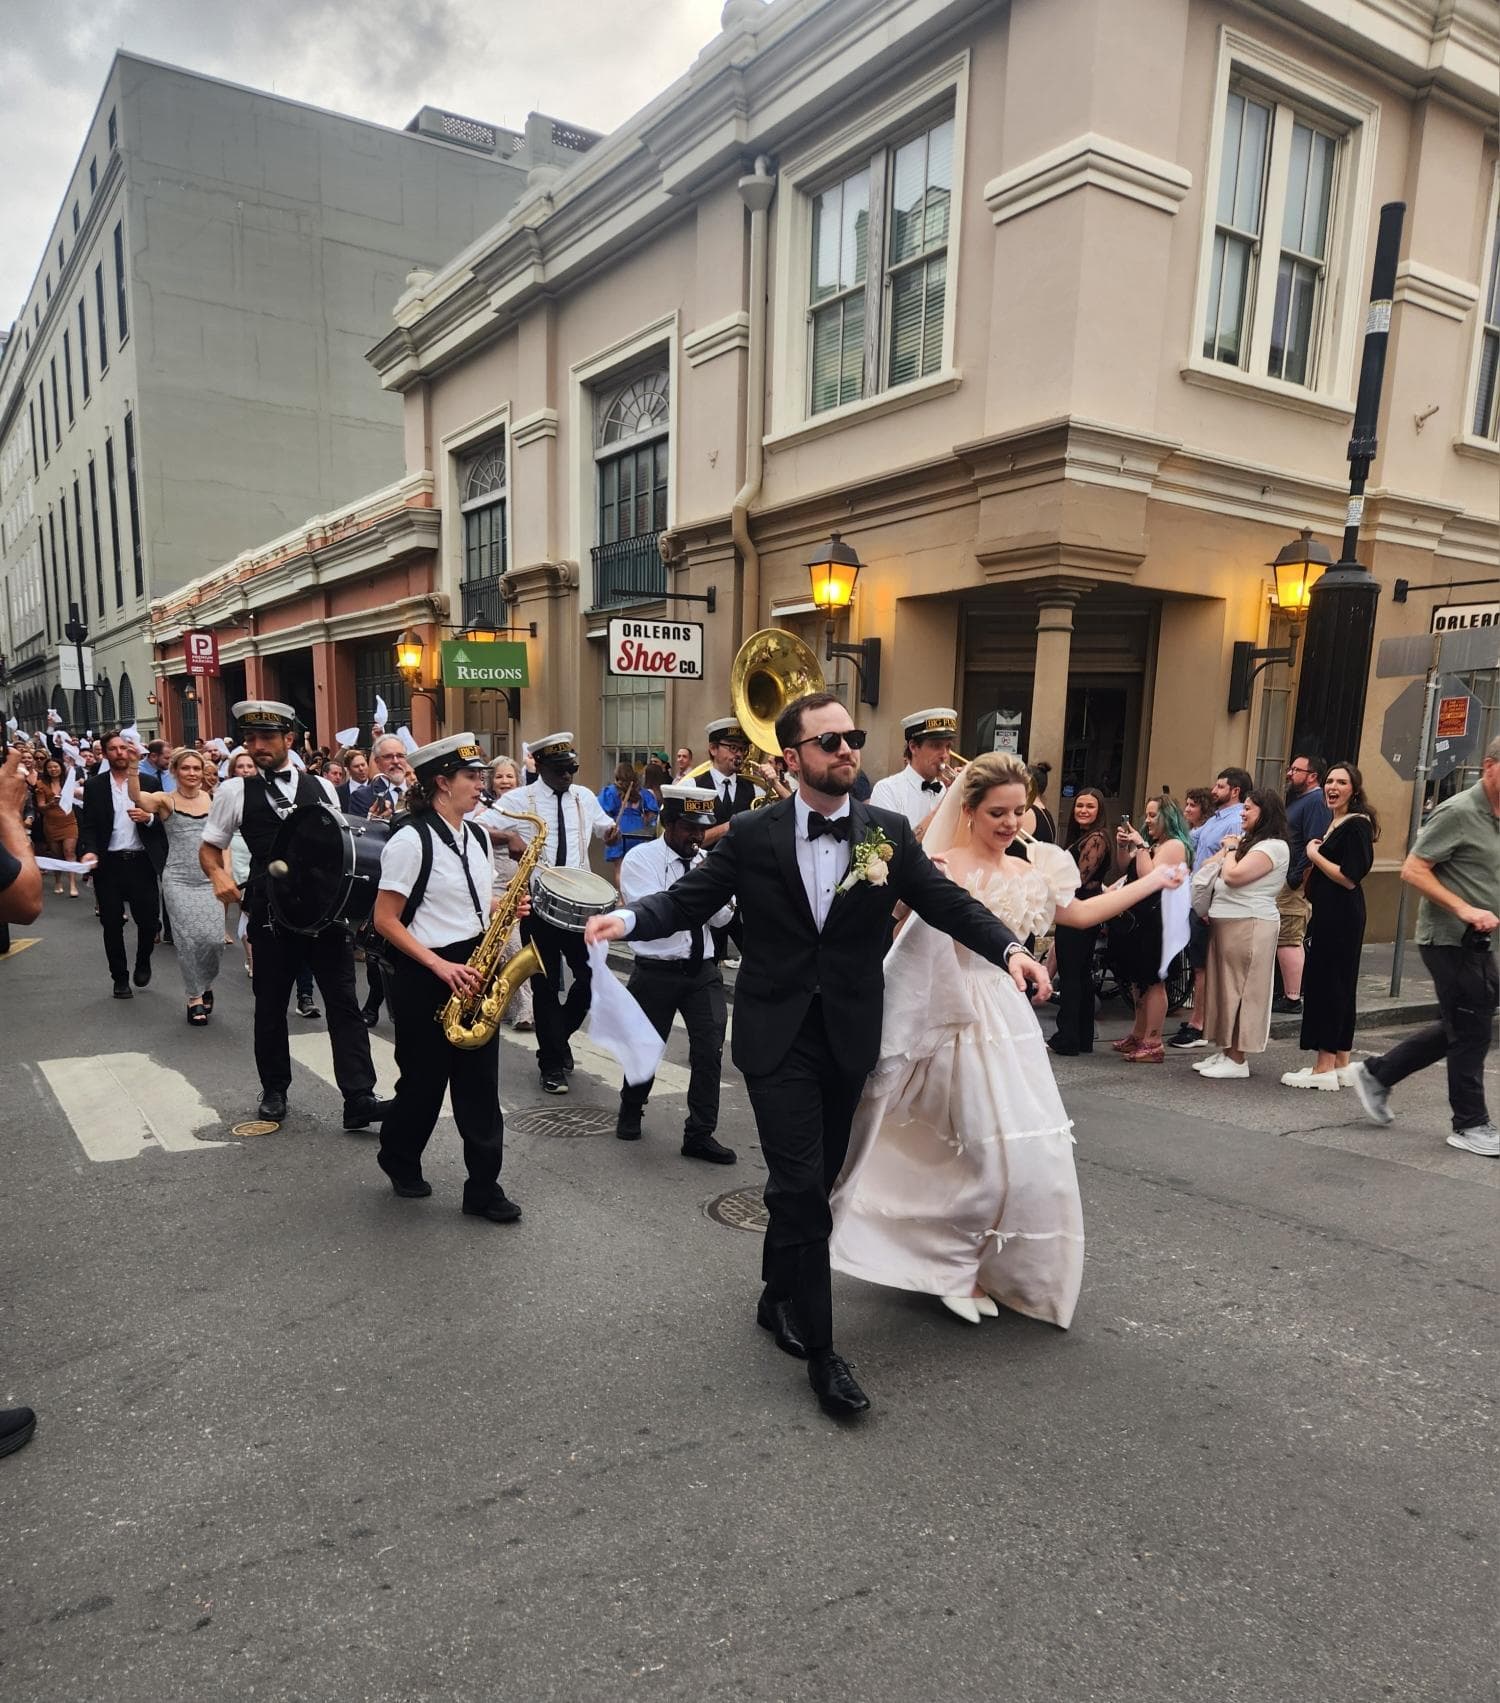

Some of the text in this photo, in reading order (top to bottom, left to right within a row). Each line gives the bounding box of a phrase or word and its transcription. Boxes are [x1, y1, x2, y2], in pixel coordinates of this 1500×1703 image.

[623, 623, 691, 641] ORLEANS
[196, 639, 209, 656] P
[617, 640, 699, 674] Shoe CO.
[457, 666, 522, 680] REGIONS
[686, 801, 702, 810] BIG
